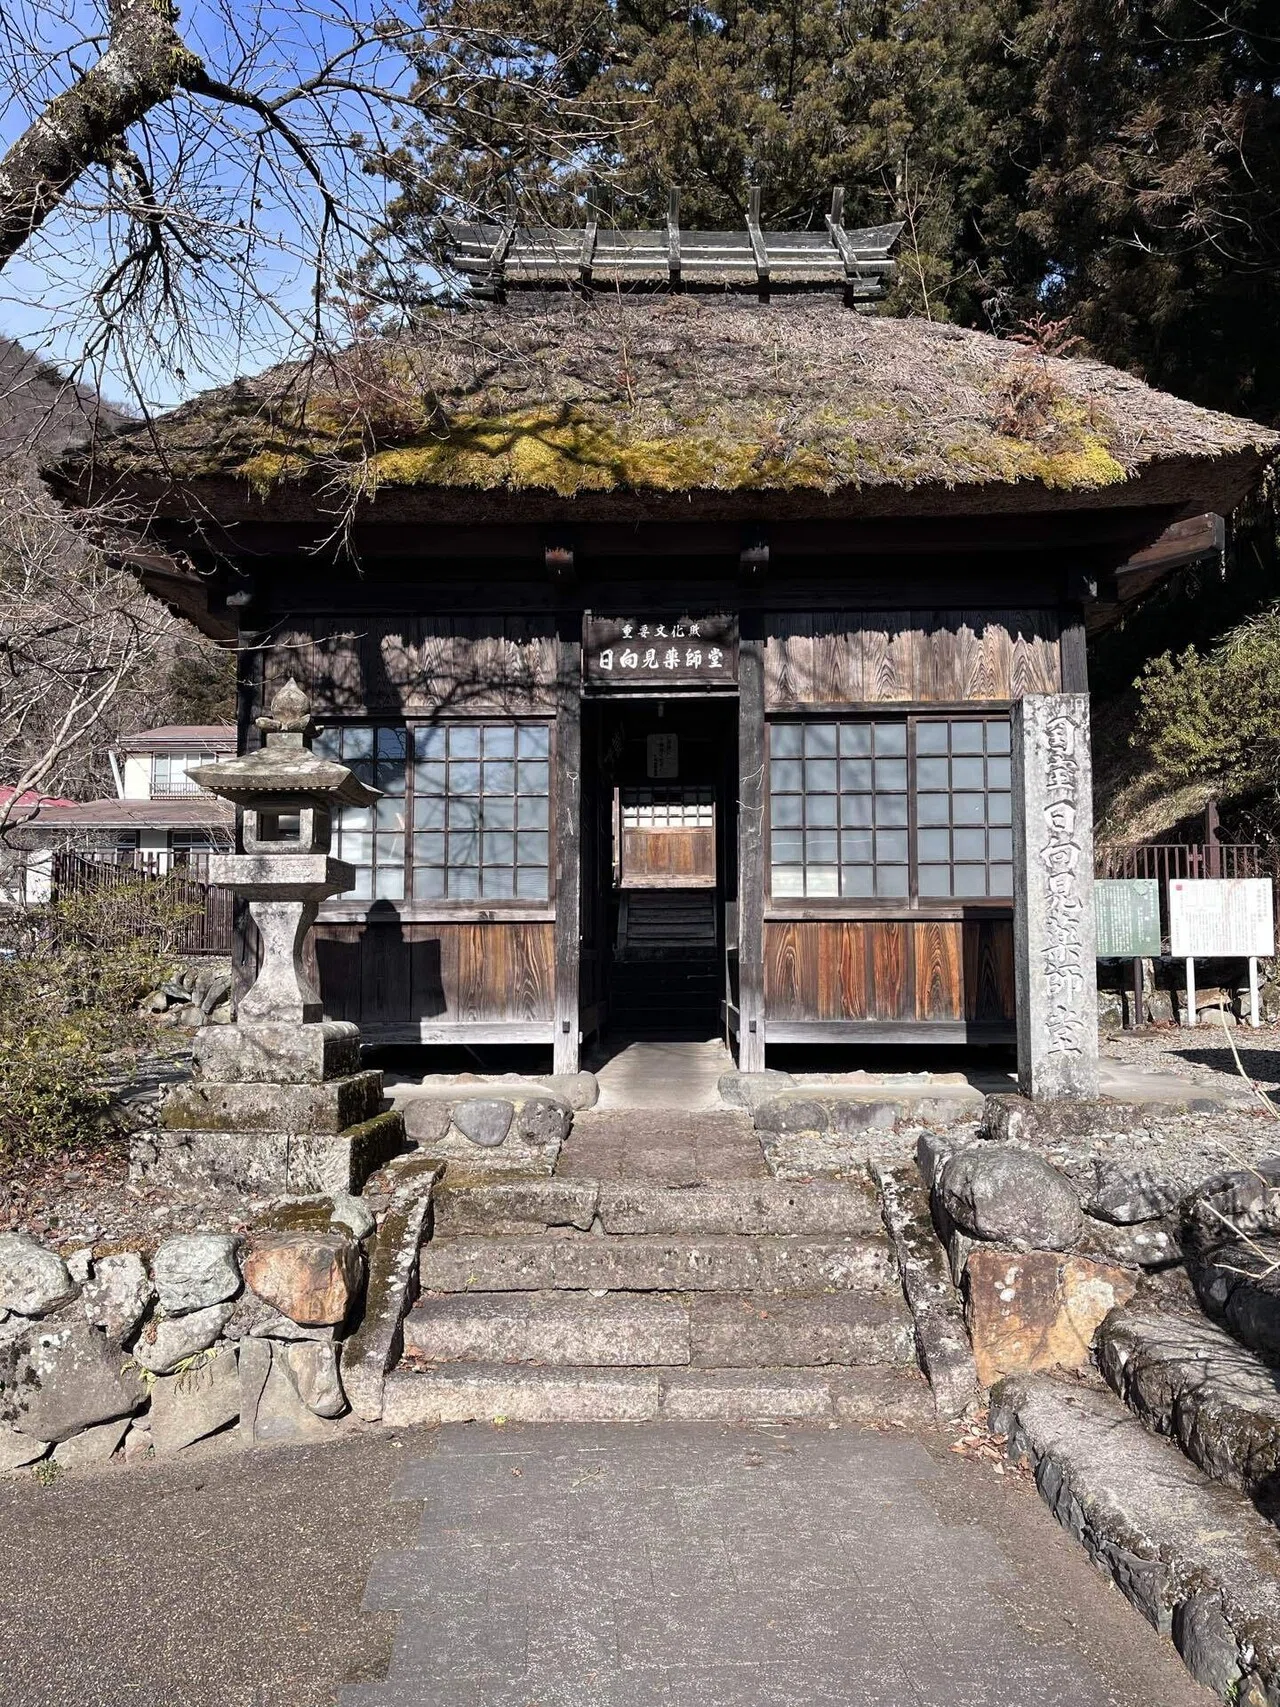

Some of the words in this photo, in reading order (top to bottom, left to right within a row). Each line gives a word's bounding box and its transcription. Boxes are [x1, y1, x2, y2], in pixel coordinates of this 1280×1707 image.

[599, 647, 724, 670] 日向見薬師堂
